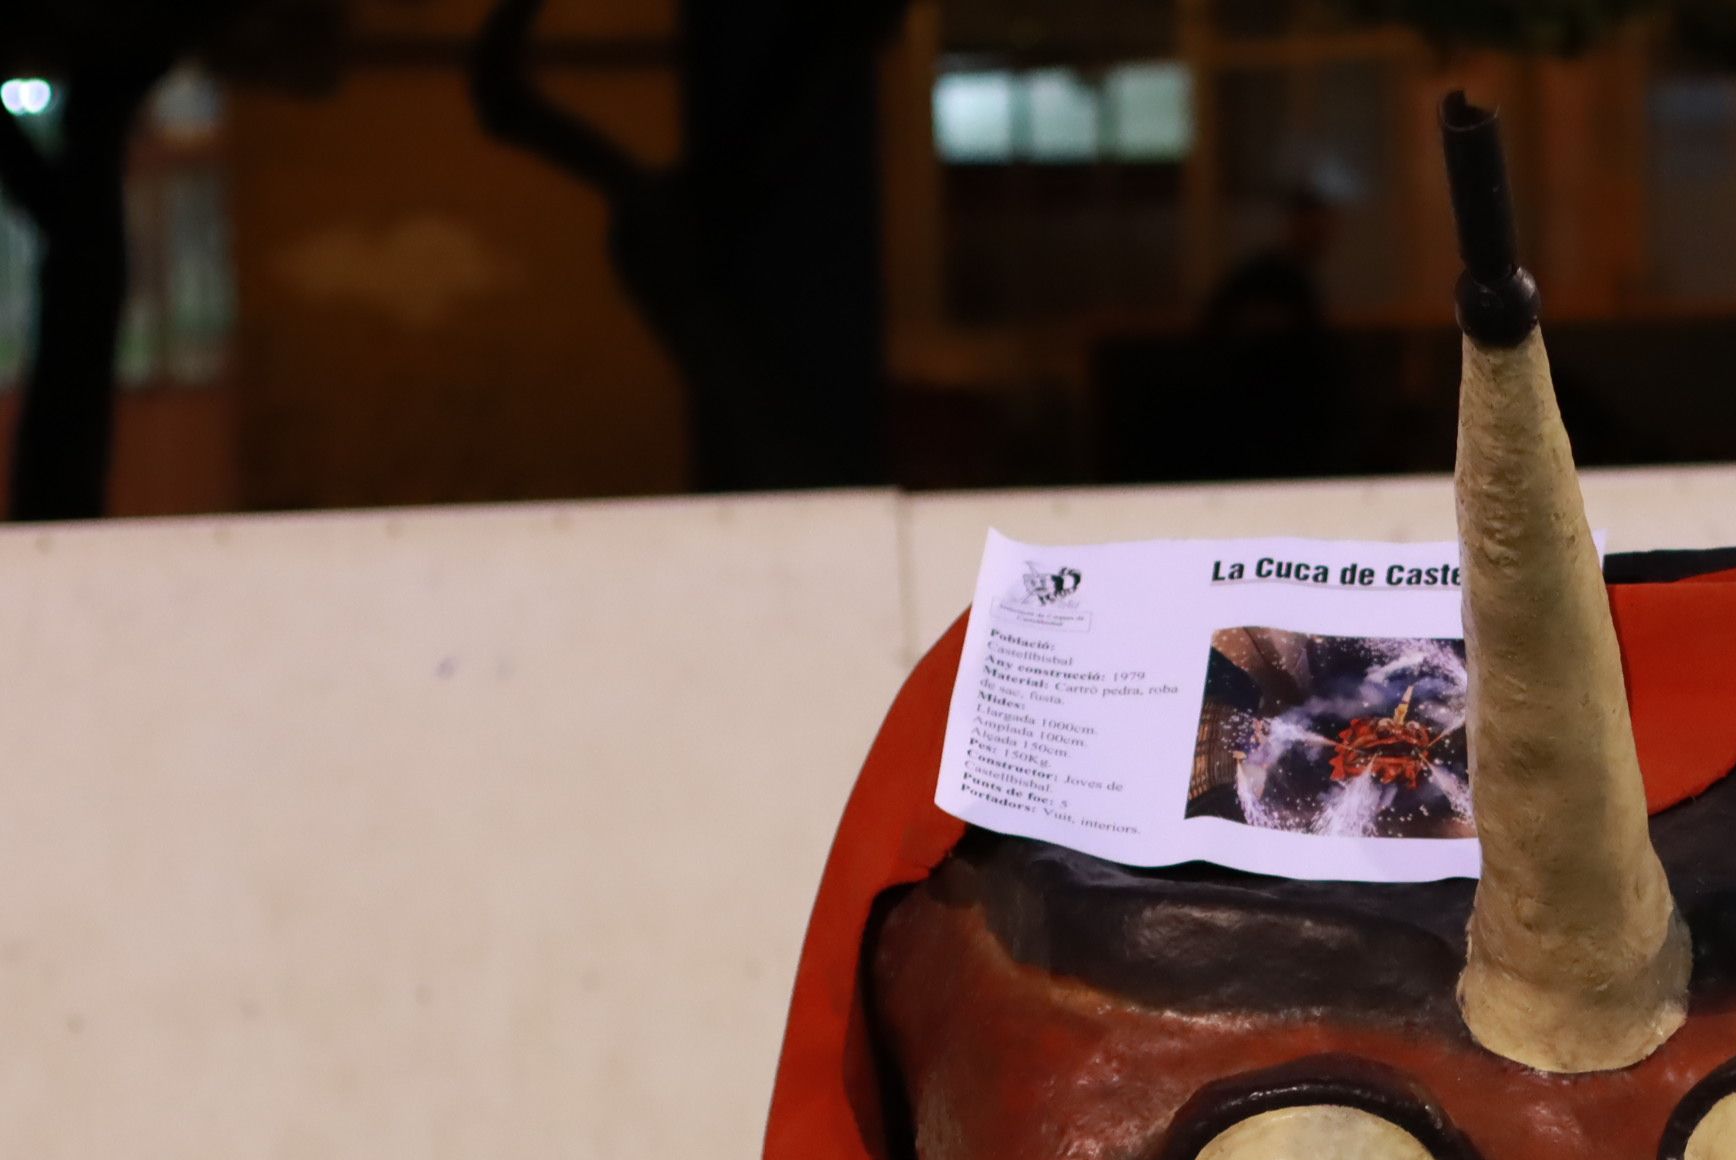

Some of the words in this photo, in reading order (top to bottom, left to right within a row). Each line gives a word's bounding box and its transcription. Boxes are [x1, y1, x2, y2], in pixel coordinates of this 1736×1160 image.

[1212, 560, 1245, 581] La
[1255, 557, 1329, 583] Cuca
[1340, 563, 1375, 586] de
[987, 641, 1073, 666] Castellbisbal
[984, 665, 1049, 690] Material:
[1102, 686, 1144, 698] pedra,
[1148, 685, 1179, 695] roba
[985, 655, 1013, 670] Any
[1113, 671, 1145, 682] 1979
[980, 679, 995, 690] de
[979, 690, 1025, 710] Mides:
[973, 715, 1033, 738] Amplada
[1039, 731, 1087, 748] 100cm.
[976, 703, 1035, 726] Llargada
[1041, 718, 1098, 736] 1000cm.
[969, 737, 997, 754] Pes:
[971, 727, 1017, 748] Alçada
[966, 749, 1058, 782] Constructor:
[1063, 775, 1102, 790] Joves
[1106, 780, 1123, 792] de
[963, 771, 1002, 793] Punts
[1006, 787, 1024, 798] de
[961, 783, 1036, 814] Portadors:
